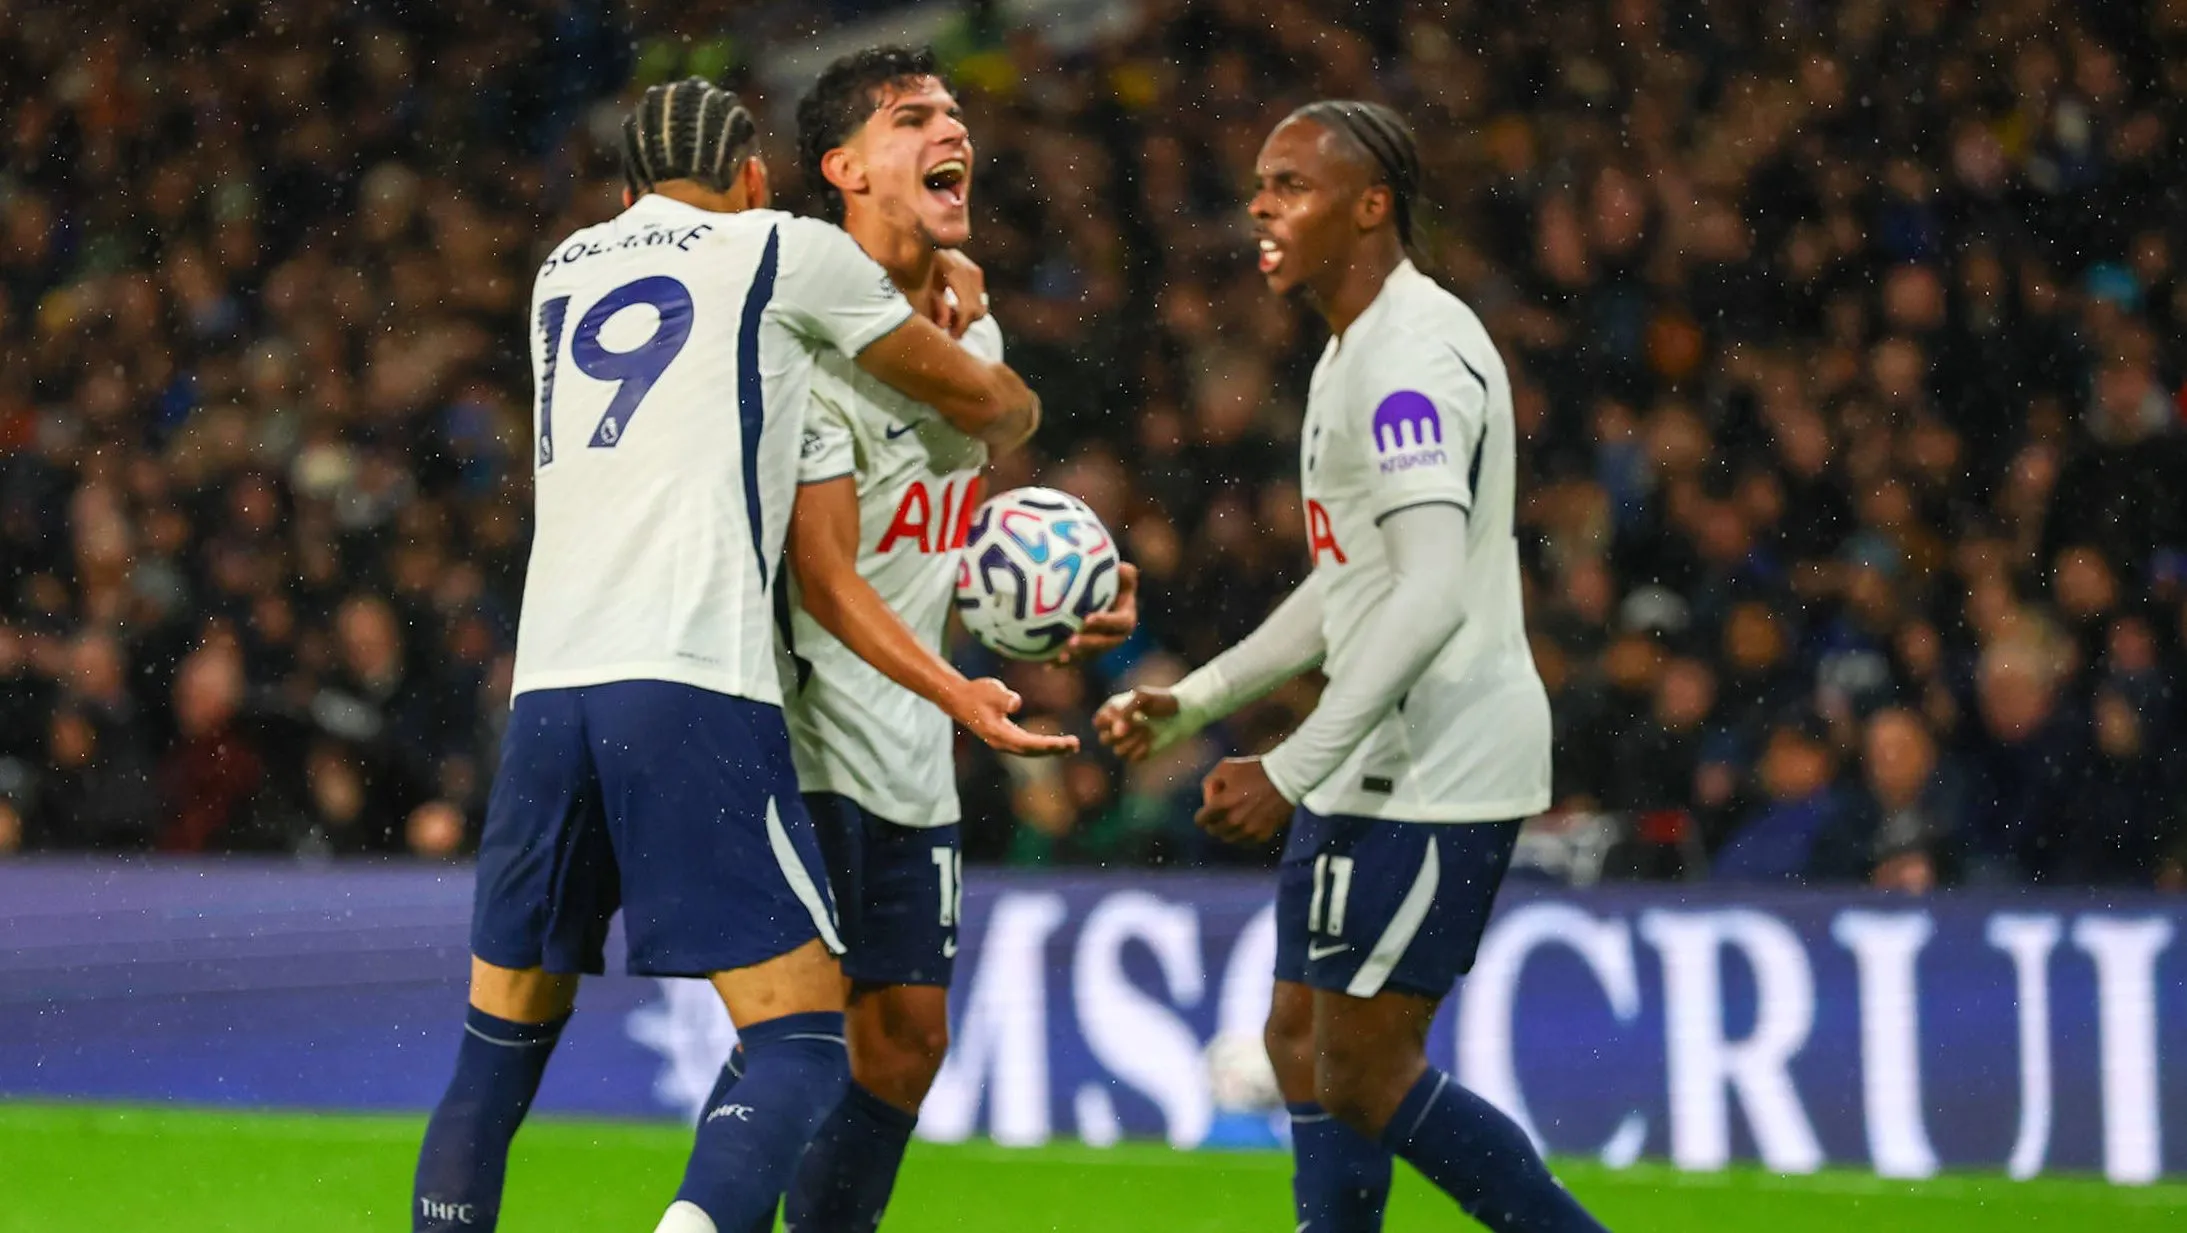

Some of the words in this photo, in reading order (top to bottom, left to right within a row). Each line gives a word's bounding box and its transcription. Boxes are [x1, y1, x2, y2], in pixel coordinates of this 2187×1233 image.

[543, 223, 713, 277] SOLE
[538, 275, 694, 468] 19
[1308, 853, 1354, 937] 11
[1455, 902, 2175, 1185] CRUI
[420, 1196, 474, 1225] THFC
